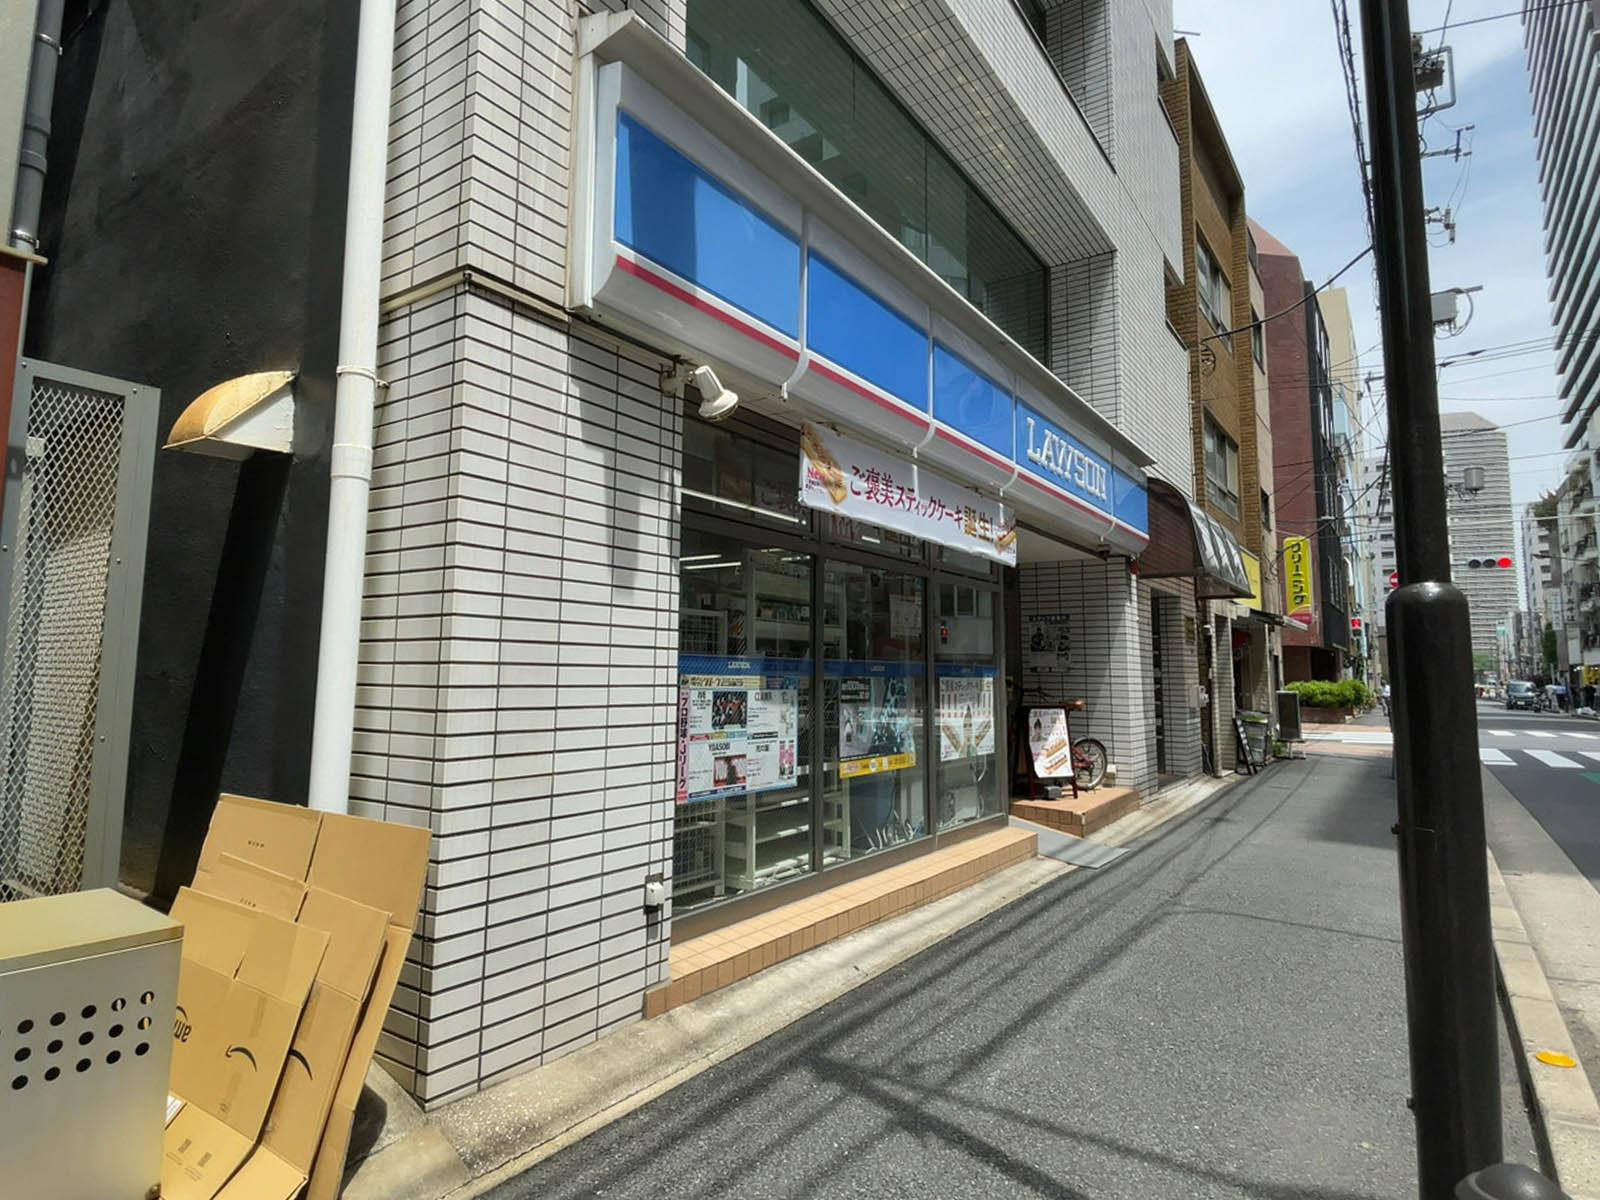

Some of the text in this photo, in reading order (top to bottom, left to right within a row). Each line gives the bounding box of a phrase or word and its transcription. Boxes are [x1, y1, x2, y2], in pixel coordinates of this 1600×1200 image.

[1027, 416, 1107, 500] LAWSON
[1291, 542, 1306, 605] クリーニング
